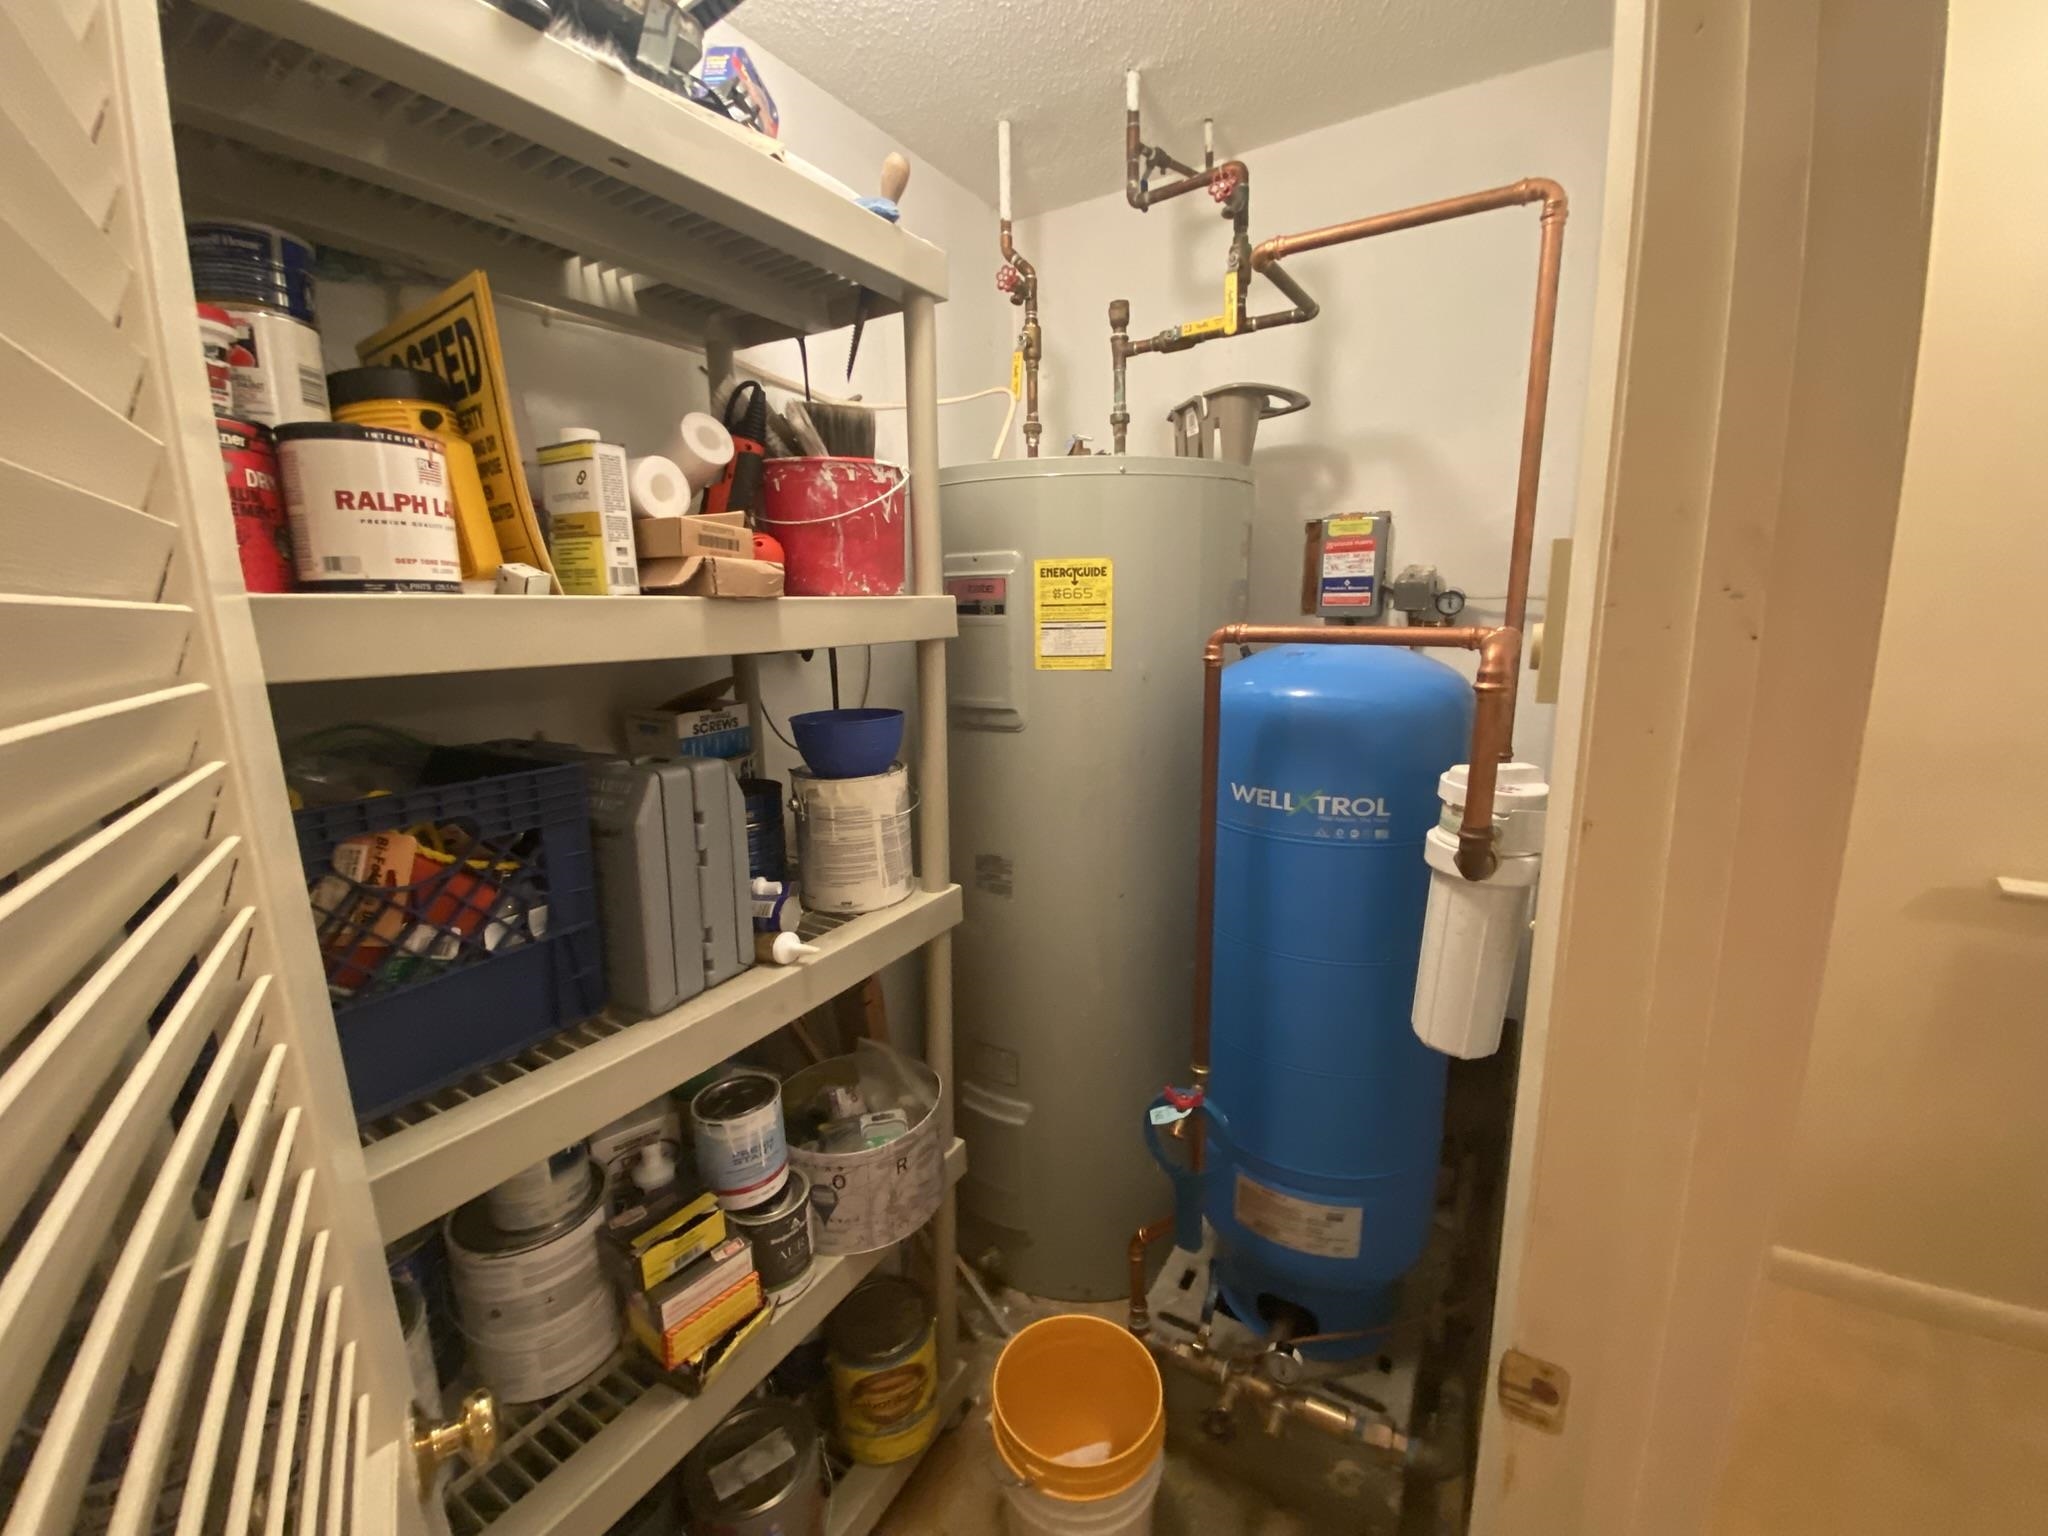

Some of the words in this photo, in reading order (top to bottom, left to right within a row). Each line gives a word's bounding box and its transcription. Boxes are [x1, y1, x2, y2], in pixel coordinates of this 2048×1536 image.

[334, 490, 429, 515] RALPH
[1052, 587, 1093, 600] $665
[692, 717, 739, 736] SCREWS
